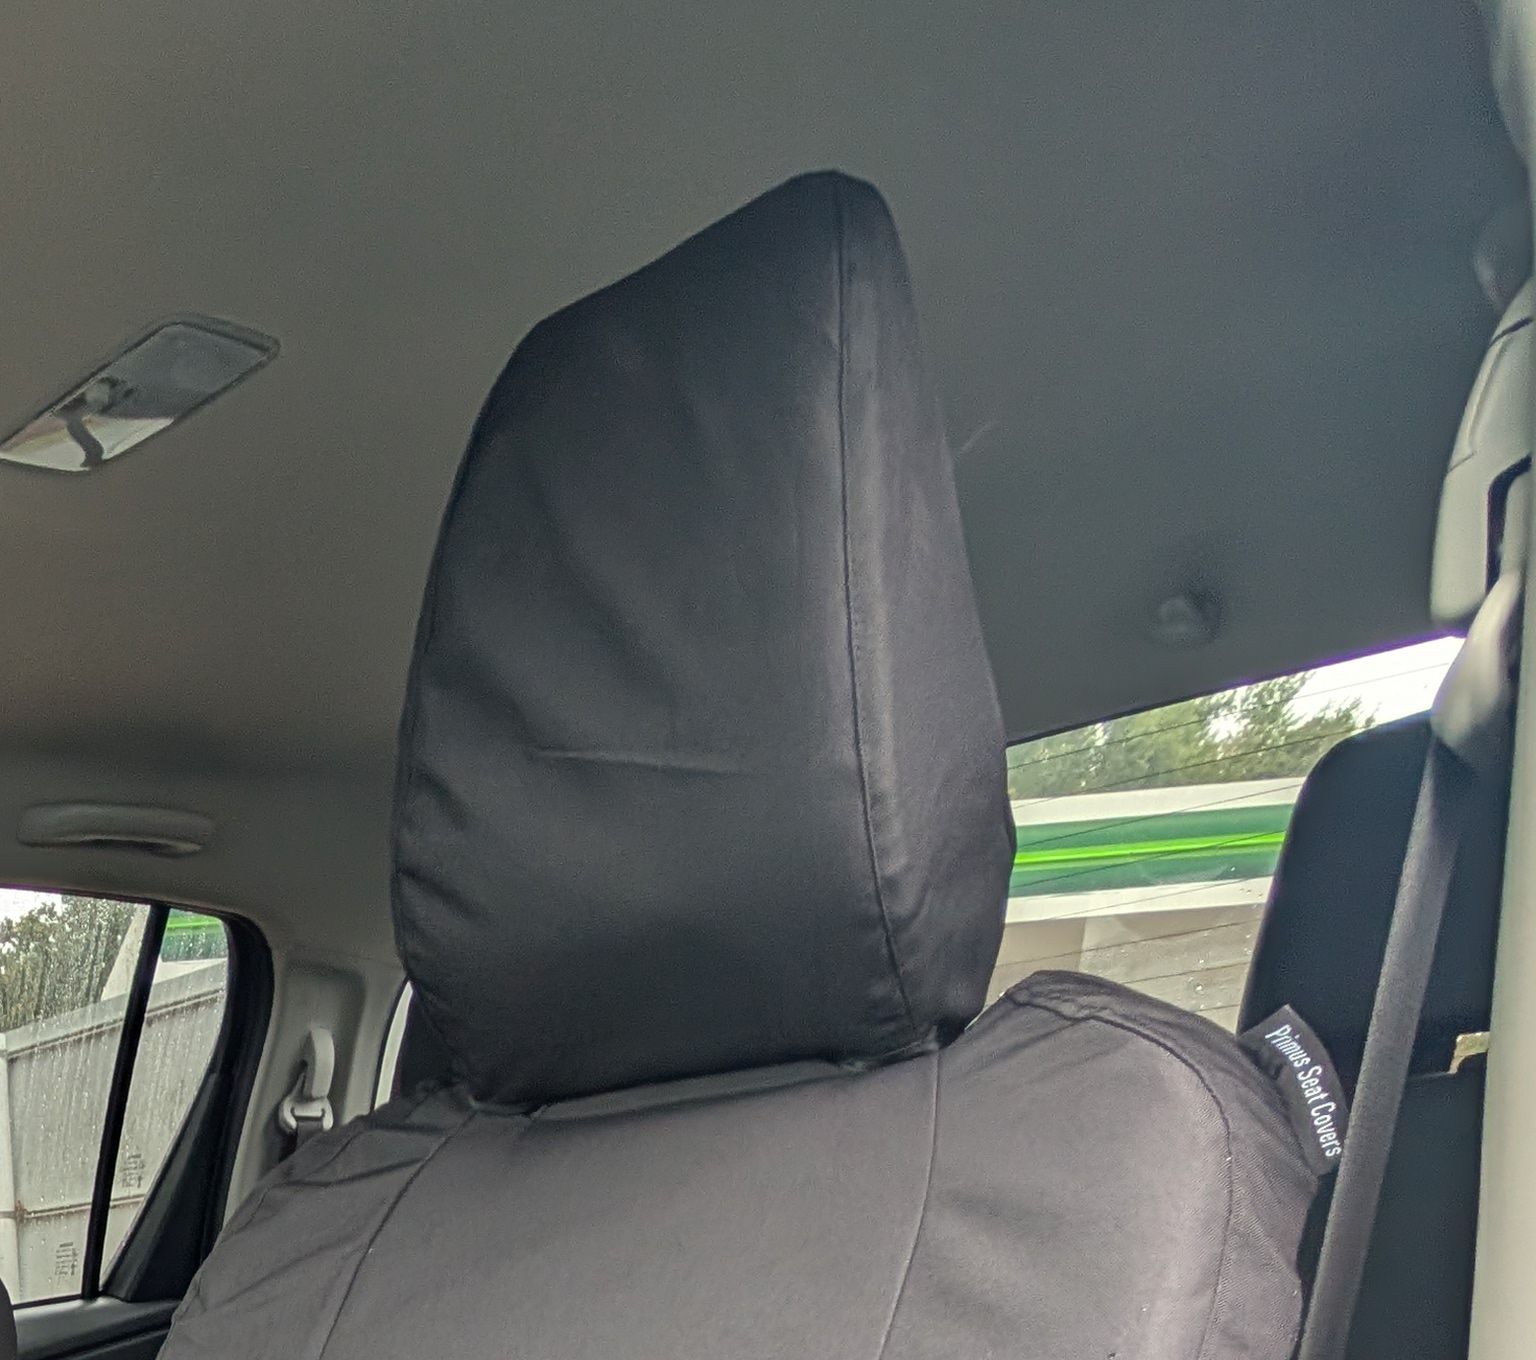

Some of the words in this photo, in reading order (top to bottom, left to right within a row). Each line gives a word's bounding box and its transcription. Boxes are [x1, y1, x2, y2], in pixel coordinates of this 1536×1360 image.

[1265, 1024, 1311, 1068] Primus
[1297, 1065, 1329, 1104] Seat
[1311, 1102, 1342, 1157] Covers
